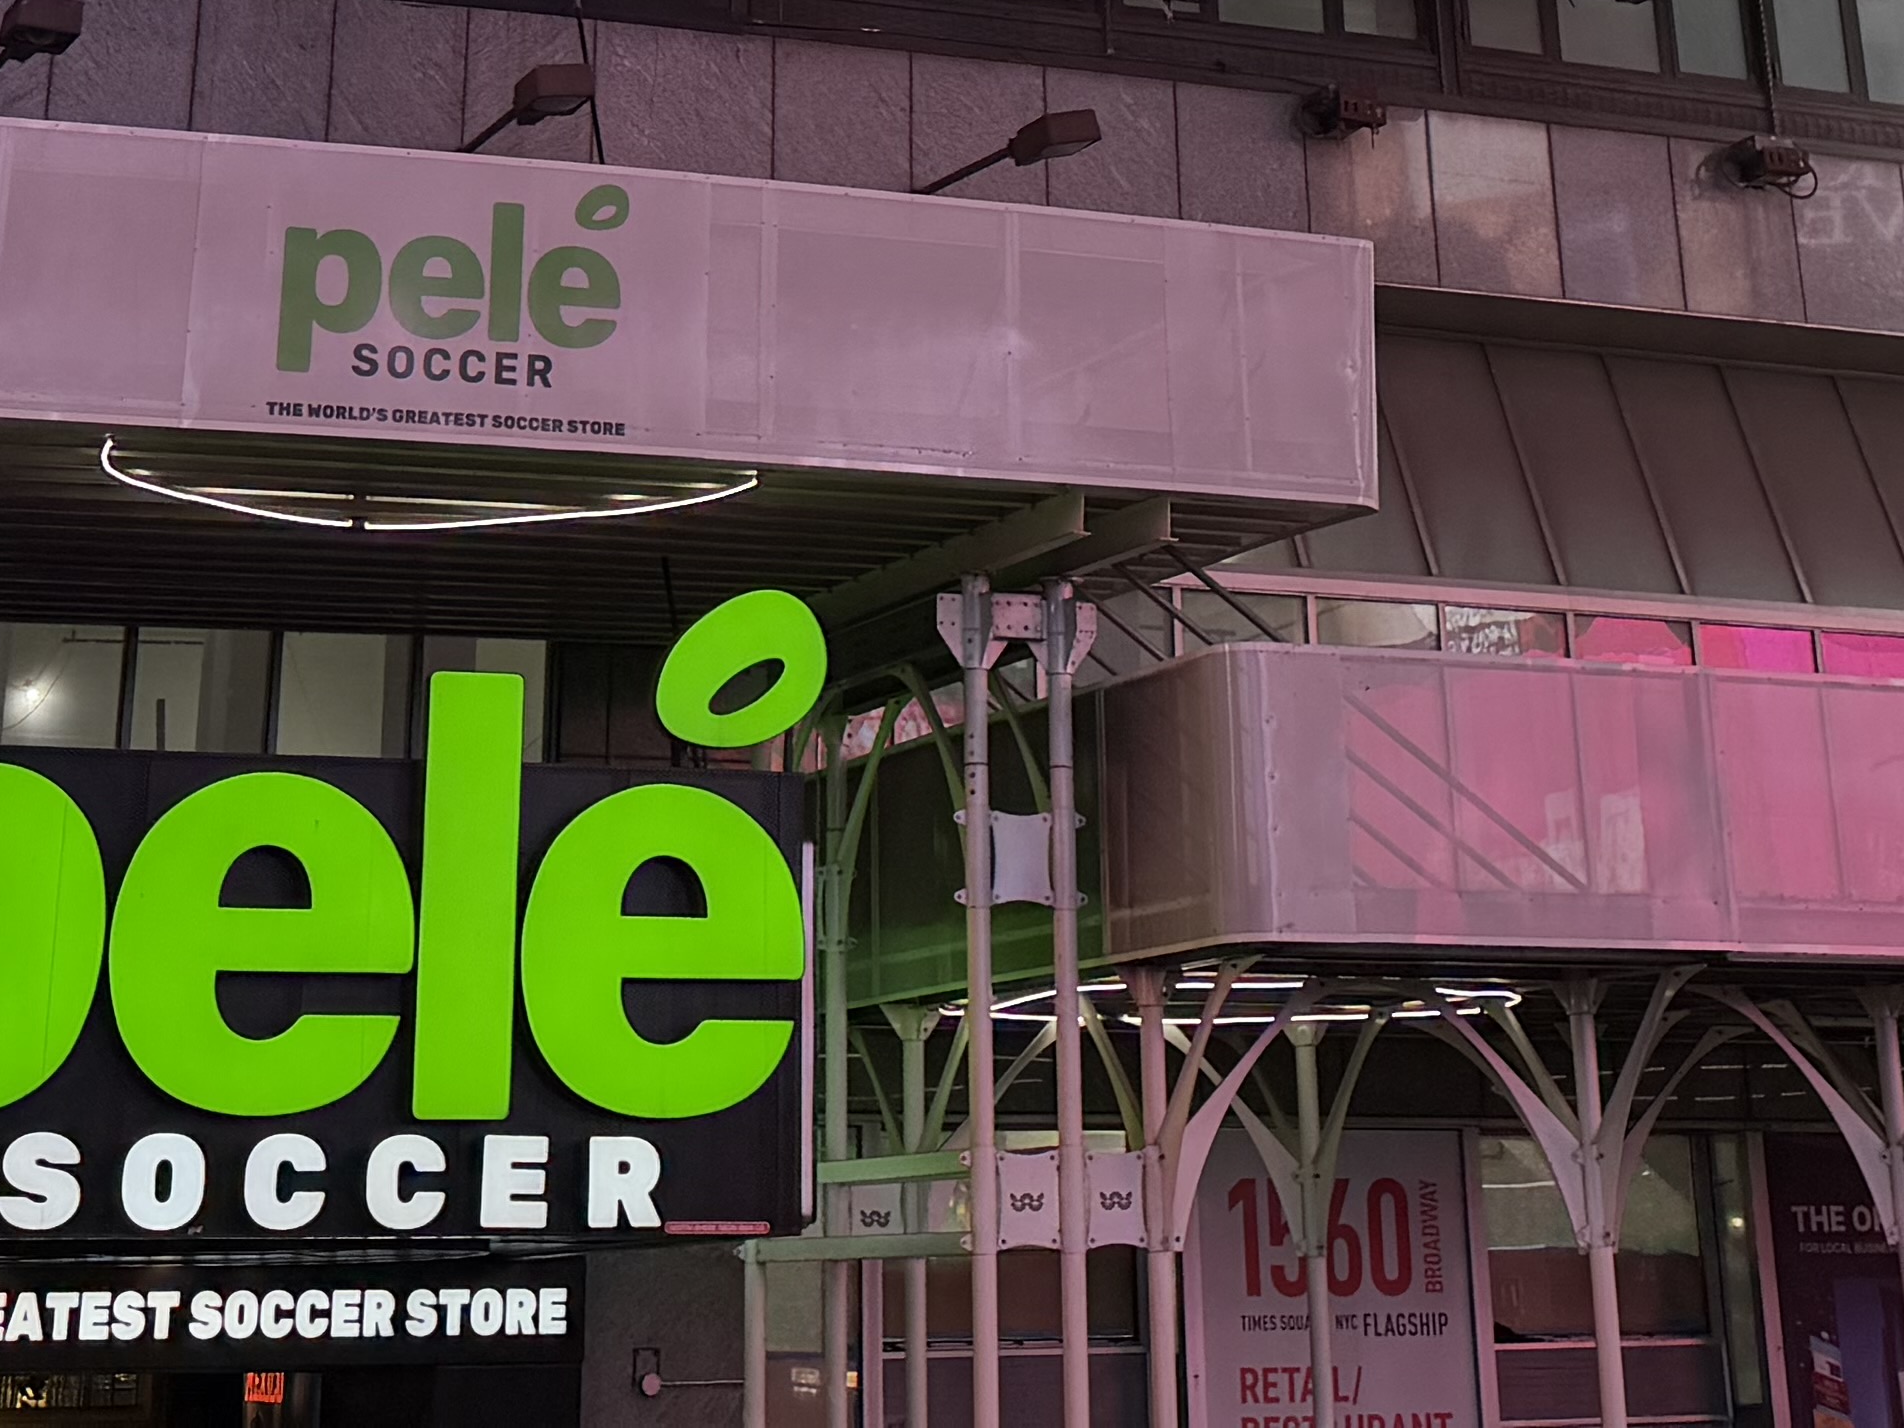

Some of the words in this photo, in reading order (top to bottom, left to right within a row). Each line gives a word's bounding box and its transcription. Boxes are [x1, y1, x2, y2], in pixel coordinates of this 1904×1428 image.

[350, 342, 554, 389] SOCCER
[266, 400, 304, 419] THE
[307, 402, 389, 424] WORLD'S
[391, 408, 488, 429] GREATEST
[491, 413, 564, 433] SOCCER
[567, 417, 626, 437] STORE
[1228, 1177, 1412, 1298] 1560
[1424, 1179, 1442, 1294] BROADWAY
[1790, 1204, 1846, 1234] THE
[189, 1290, 395, 1341] SOCCER
[403, 1286, 569, 1337] STORE
[1240, 1314, 1277, 1332] TIMES
[1280, 1314, 1313, 1332] SQUA
[1335, 1313, 1359, 1331] NYC
[1363, 1311, 1449, 1338] FLAGSHIP
[1239, 1364, 1363, 1406] RETAL/
